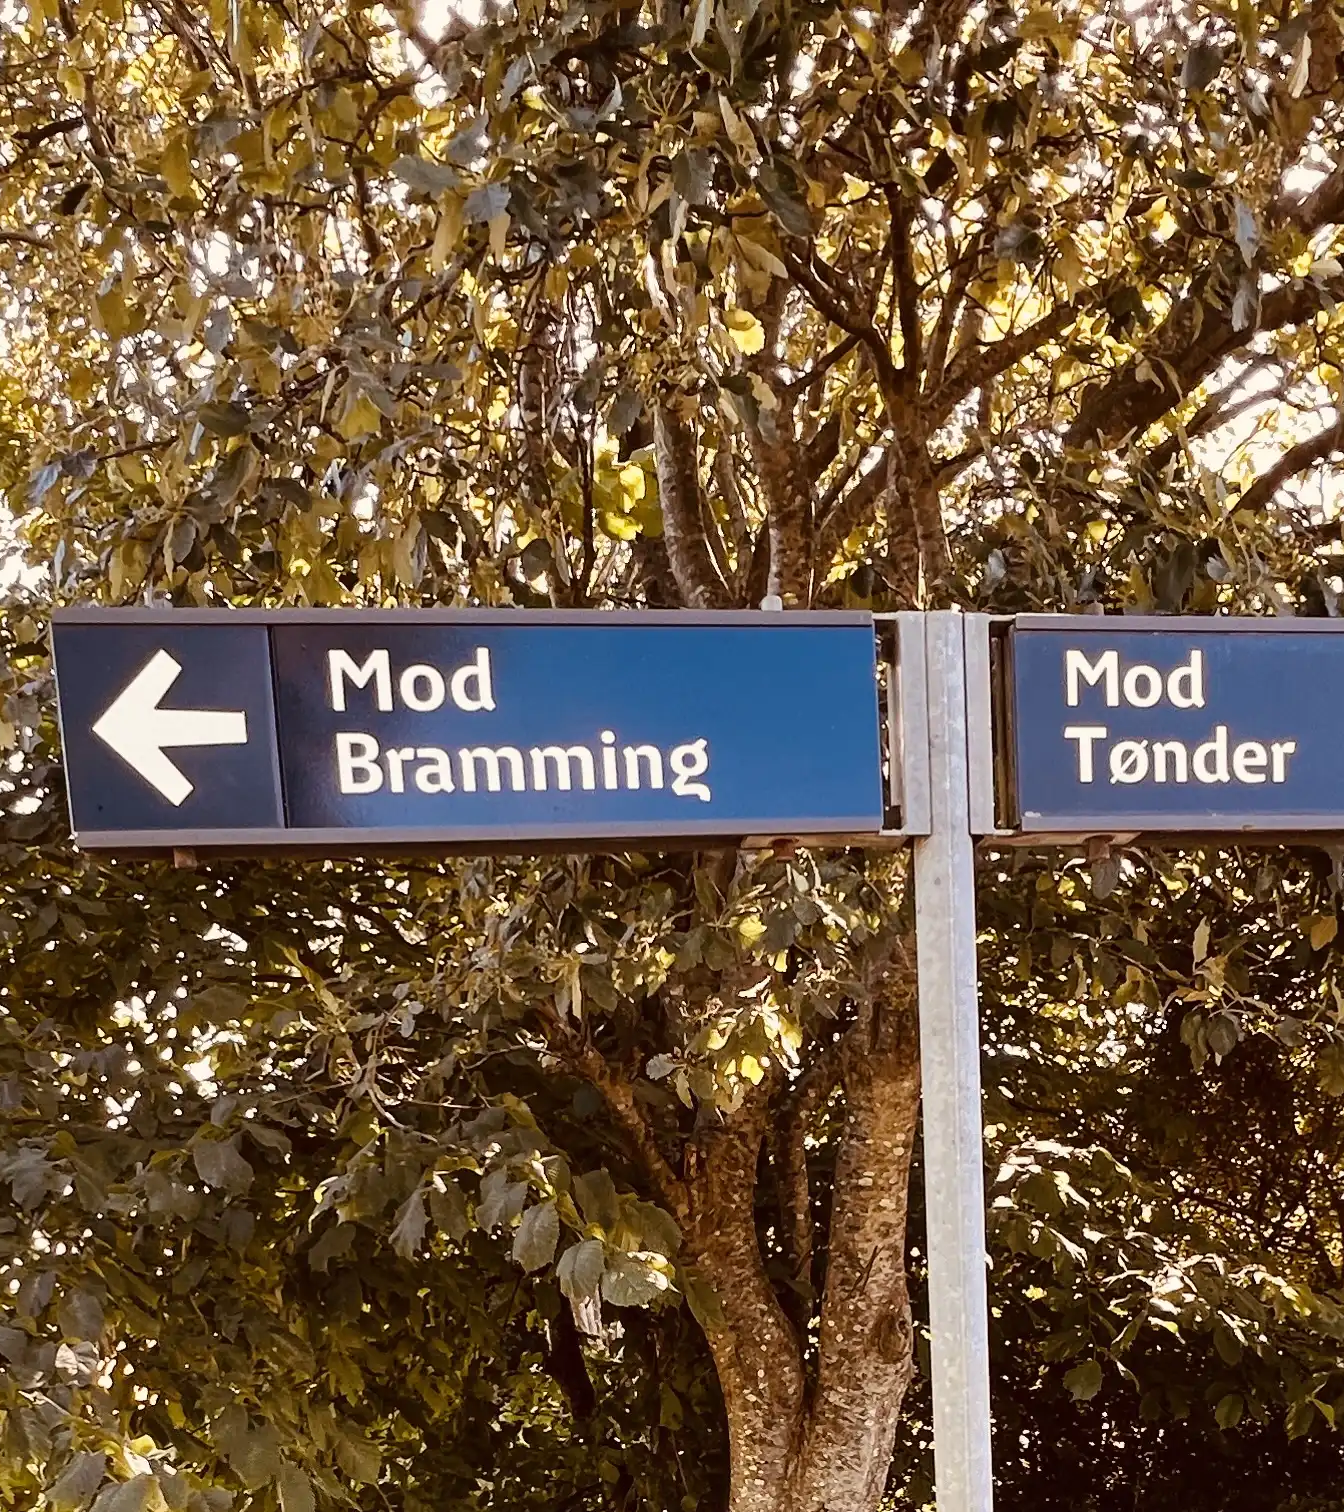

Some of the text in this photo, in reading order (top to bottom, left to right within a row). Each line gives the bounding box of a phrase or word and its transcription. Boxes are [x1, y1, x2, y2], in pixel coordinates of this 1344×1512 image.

[327, 647, 497, 713] Mod
[1064, 648, 1207, 710] Mod
[334, 732, 712, 804] Bramming
[1062, 725, 1297, 786] Tønder
